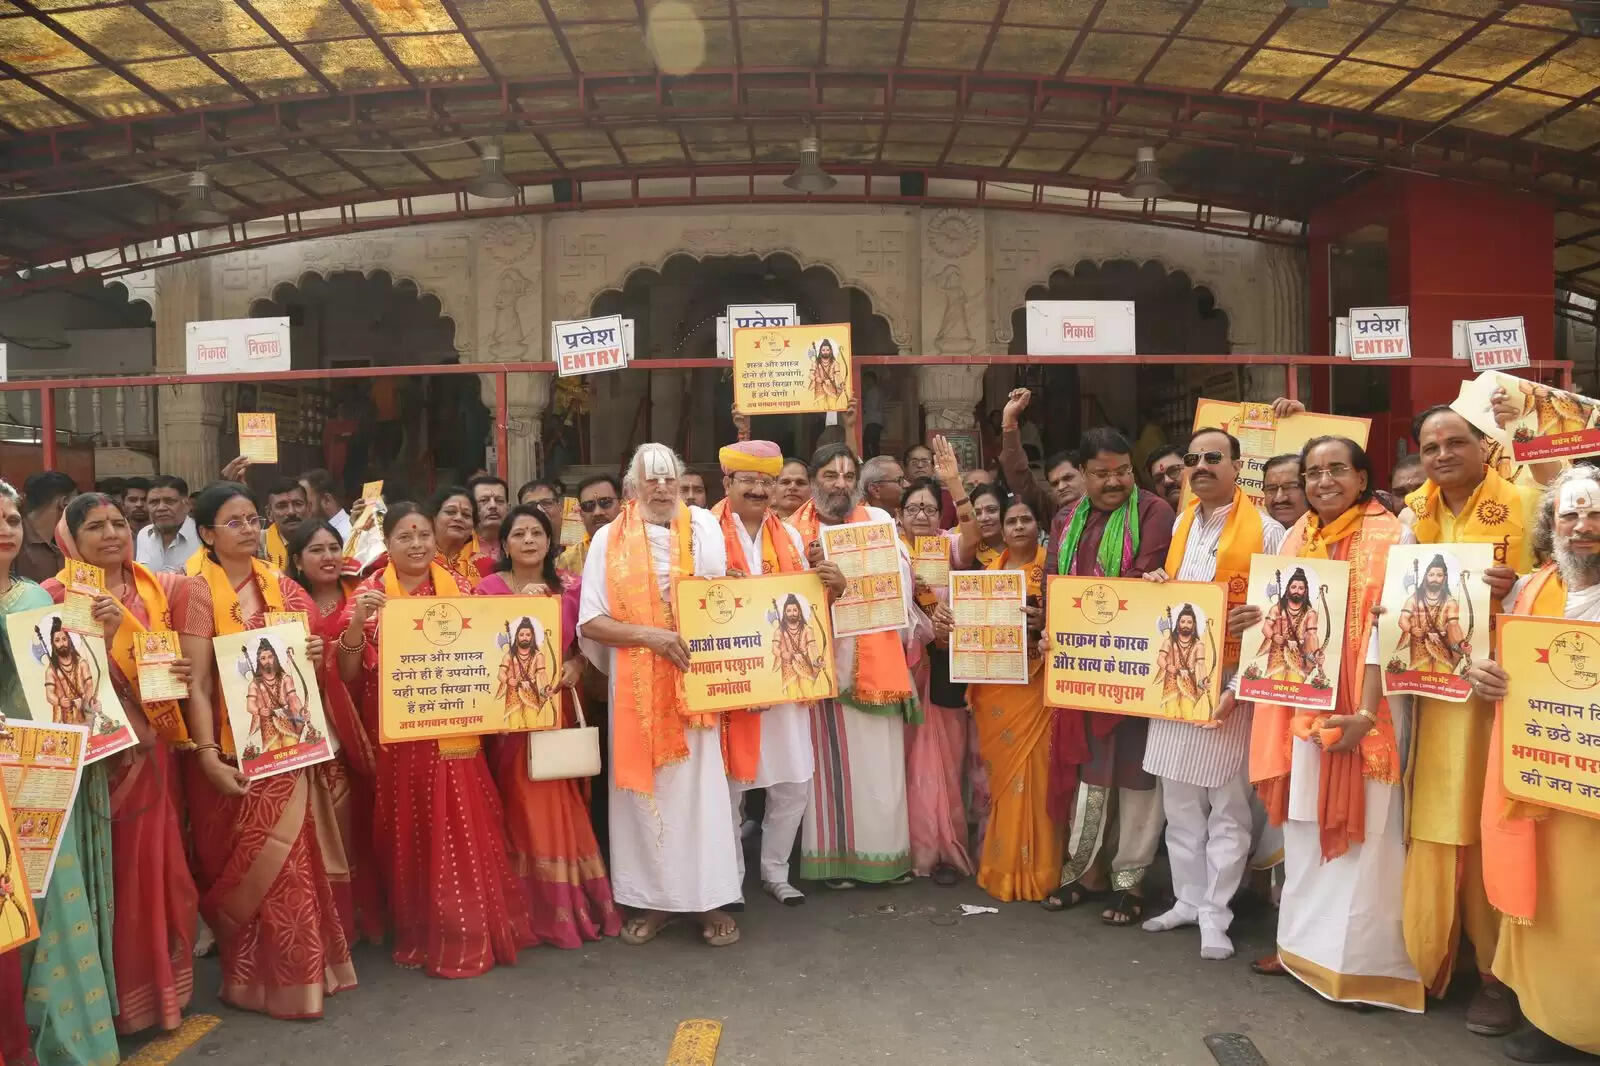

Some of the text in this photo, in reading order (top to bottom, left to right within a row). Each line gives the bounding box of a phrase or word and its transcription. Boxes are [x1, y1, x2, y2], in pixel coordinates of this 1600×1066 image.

[1063, 322, 1095, 340] निकास
[1355, 313, 1401, 334] प्रवेश
[562, 325, 616, 349] प्रवेश
[1474, 325, 1518, 346] प्रवेश
[198, 344, 227, 361] निकास
[248, 339, 279, 356] निकास
[1354, 338, 1405, 355] ENTRY
[562, 348, 620, 370] ENTRY
[1474, 347, 1522, 367] ENTRY
[759, 370, 767, 378] ही
[689, 634, 714, 653] आओ
[715, 637, 731, 651] सब
[1056, 631, 1149, 651] पराक्रम के कारक
[400, 650, 484, 664] शस्त्र और शास्त्र
[690, 656, 764, 676] भगवान परशुराम
[1053, 652, 1150, 677] और सत्य के धारक
[420, 667, 432, 680] ही
[434, 666, 444, 679] हैं
[446, 664, 491, 678] उपयोगी,
[392, 683, 492, 698] यही पाठ सिखा गए
[706, 678, 752, 697] जन्मोत्सव
[1055, 679, 1145, 704] भगवान परशुराम
[407, 700, 417, 714] हैं
[438, 697, 464, 711] योगी
[472, 698, 477, 709] !
[1527, 697, 1585, 719] भगवान
[399, 715, 483, 730] जय भगवान परशुराम
[1525, 719, 1543, 737] के
[1545, 724, 1571, 742] छठे
[1511, 744, 1572, 769] भगवान
[1520, 768, 1543, 787] की
[1545, 776, 1573, 794] जय
